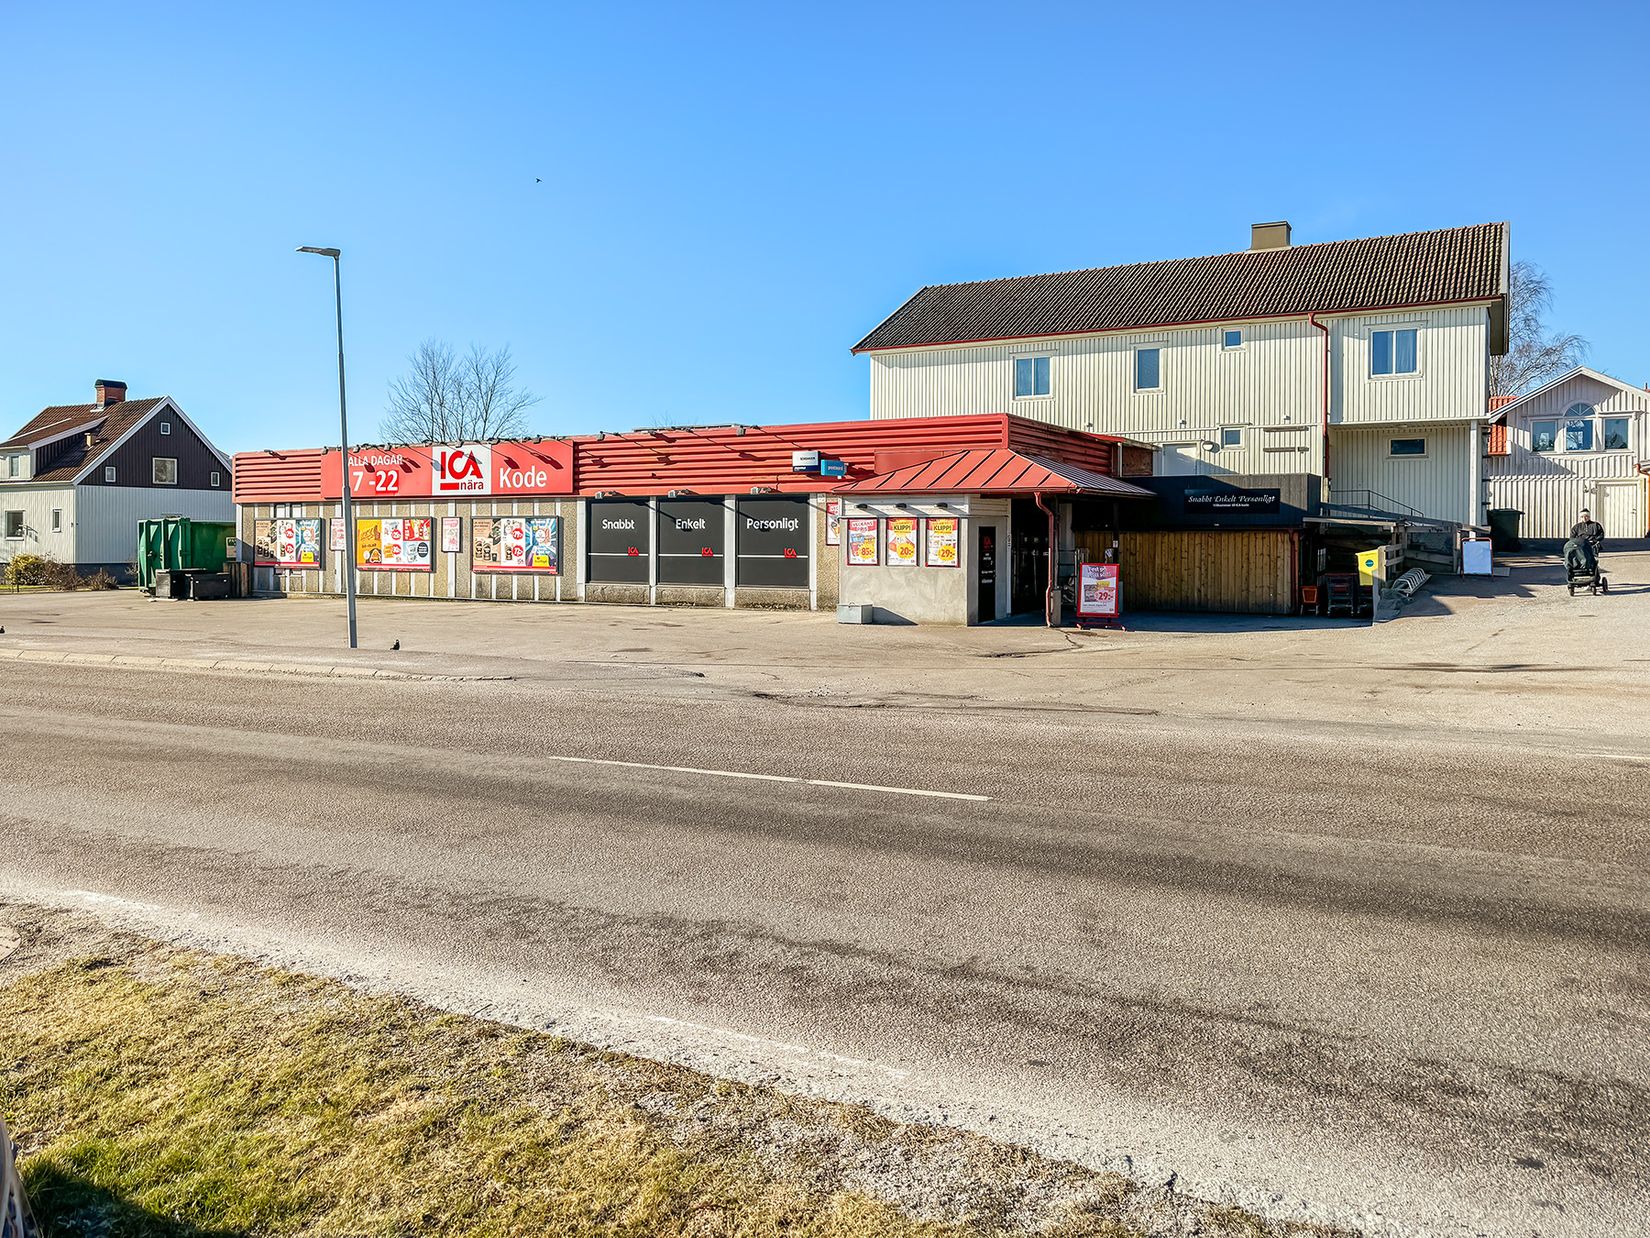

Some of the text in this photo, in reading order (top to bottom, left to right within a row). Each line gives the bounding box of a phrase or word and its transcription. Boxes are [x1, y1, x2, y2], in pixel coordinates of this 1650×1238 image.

[348, 454, 403, 467] ALLA DAGAR
[440, 450, 484, 480] ICA
[352, 471, 364, 492] 7
[499, 465, 547, 488] Kode
[460, 480, 484, 491] nära
[1188, 494, 1275, 504] Snabbt Enkelt Personligt
[602, 518, 635, 530] Snabbt
[675, 517, 706, 530] Enkelt
[746, 517, 799, 532] Personligt
[628, 546, 639, 556] ICA
[701, 547, 713, 556] ICA
[784, 547, 797, 558] ICA
